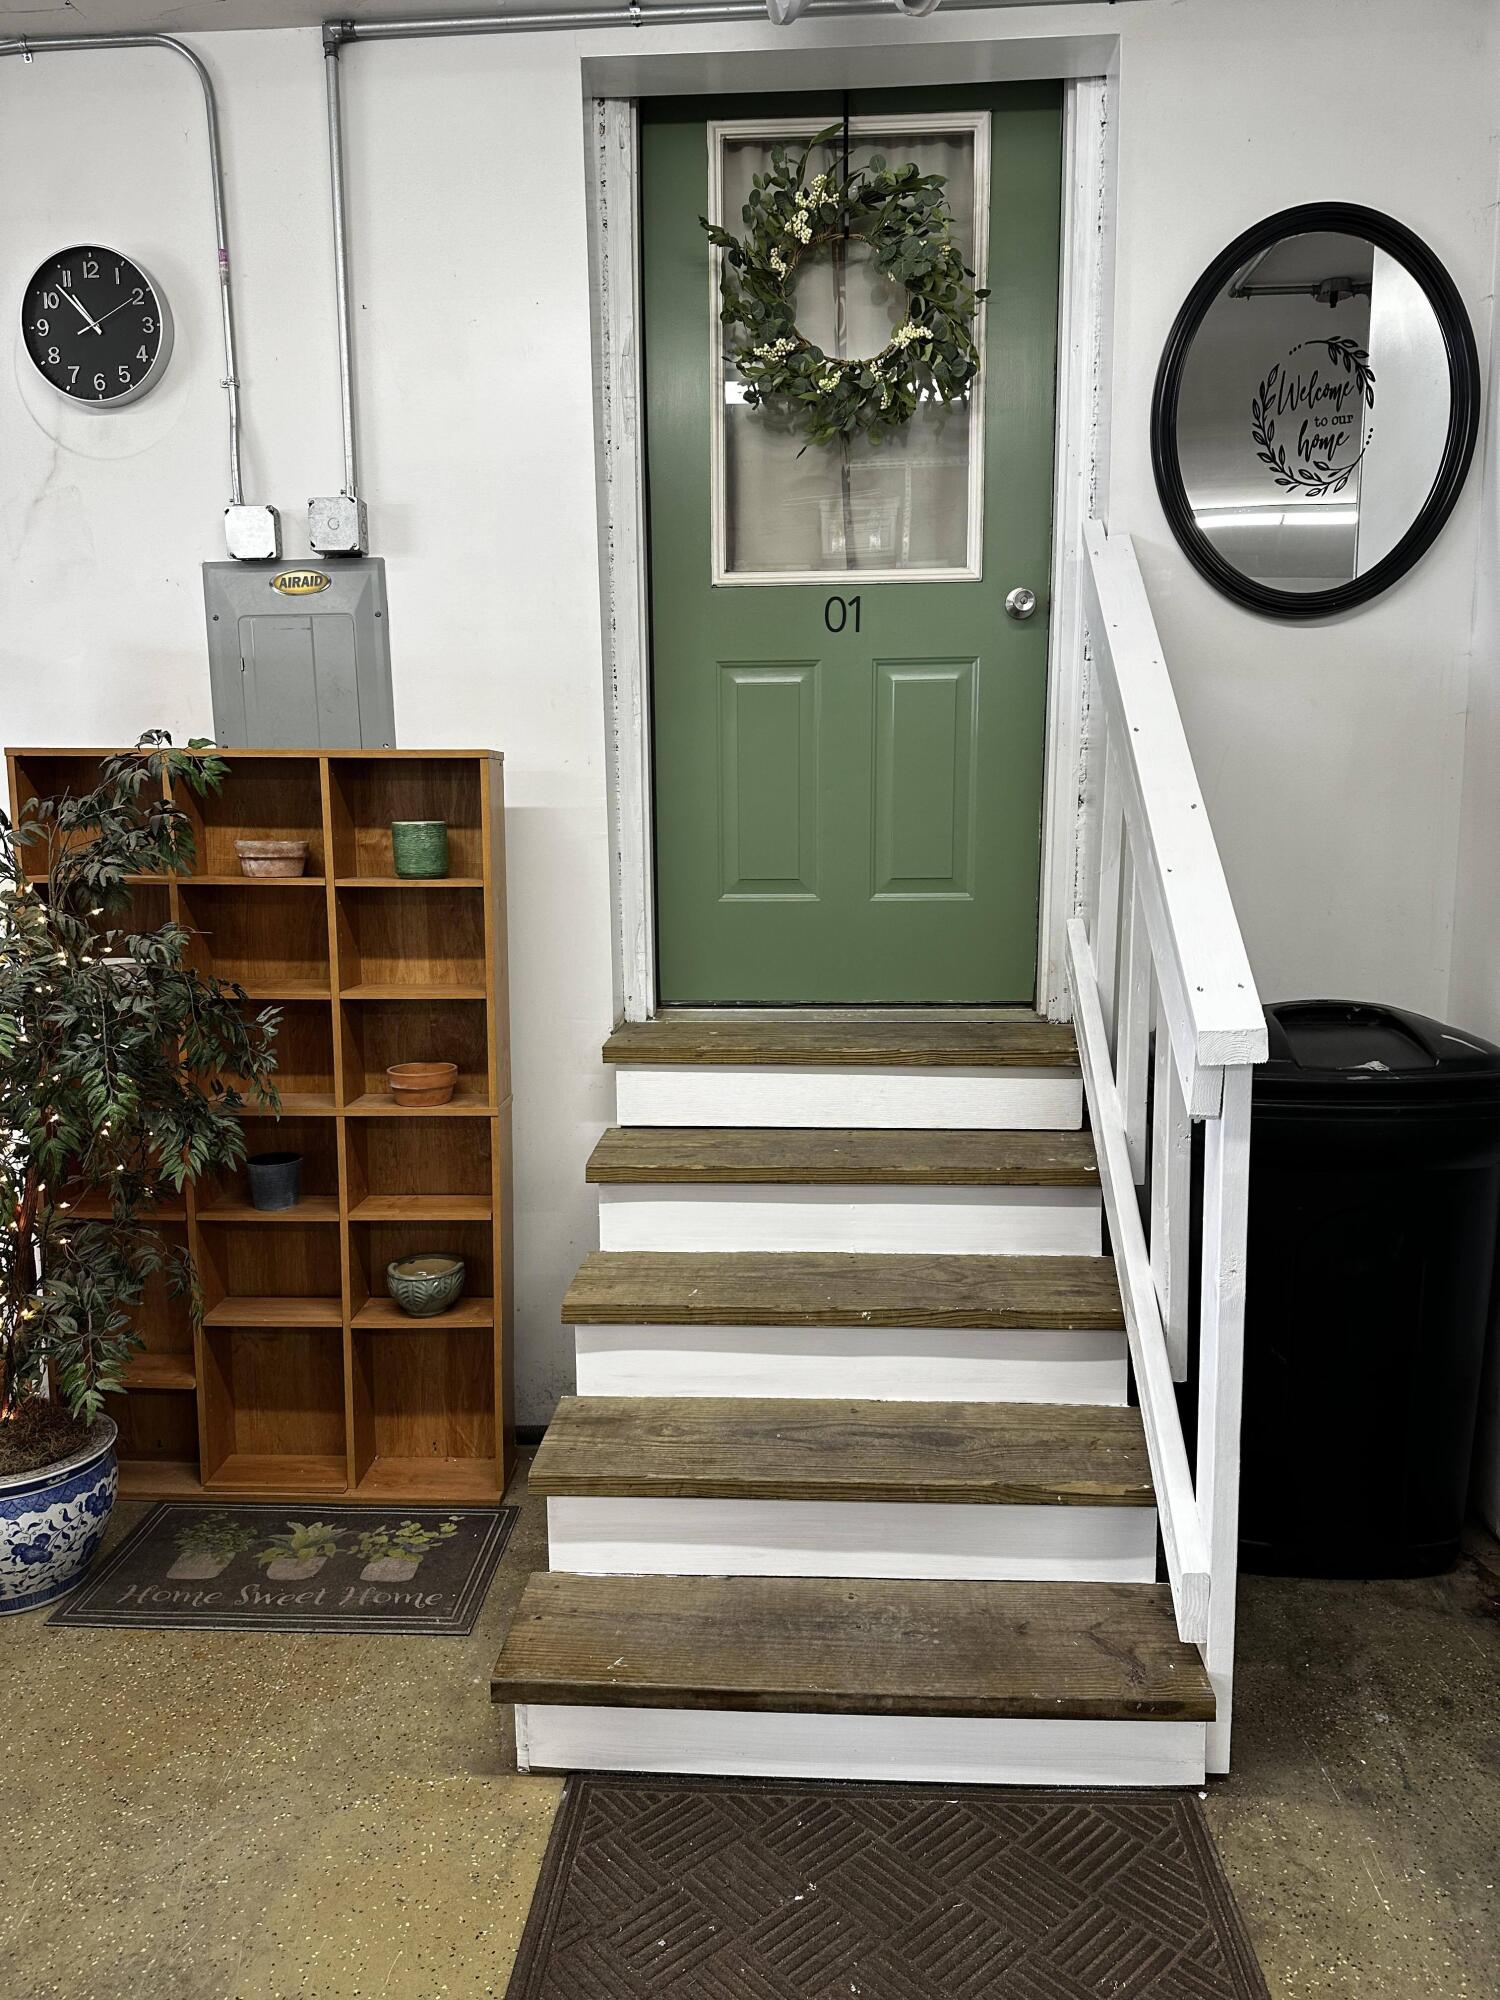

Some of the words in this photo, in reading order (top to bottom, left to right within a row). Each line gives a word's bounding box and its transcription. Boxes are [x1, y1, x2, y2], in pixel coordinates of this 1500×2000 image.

[62, 270, 72, 287] 11
[82, 260, 100, 279] 12
[114, 267, 120, 285] 1
[42, 291, 60, 309] 10
[131, 287, 145, 305] 2
[36, 318, 49, 336] 9
[141, 316, 155, 333] 3
[48, 346, 61, 364] 8
[136, 345, 149, 362] 4
[67, 365, 80, 383] 7
[93, 373, 106, 391] 6
[118, 365, 131, 383] 5
[1277, 370, 1355, 415] Welcome
[1314, 416, 1328, 427] to
[1331, 414, 1354, 425] our
[1298, 419, 1350, 462] home
[279, 576, 322, 588] AIRAID
[824, 595, 861, 633] 01
[116, 1584, 223, 1608] Home
[234, 1583, 327, 1606] Sweet
[338, 1586, 444, 1609] Home
